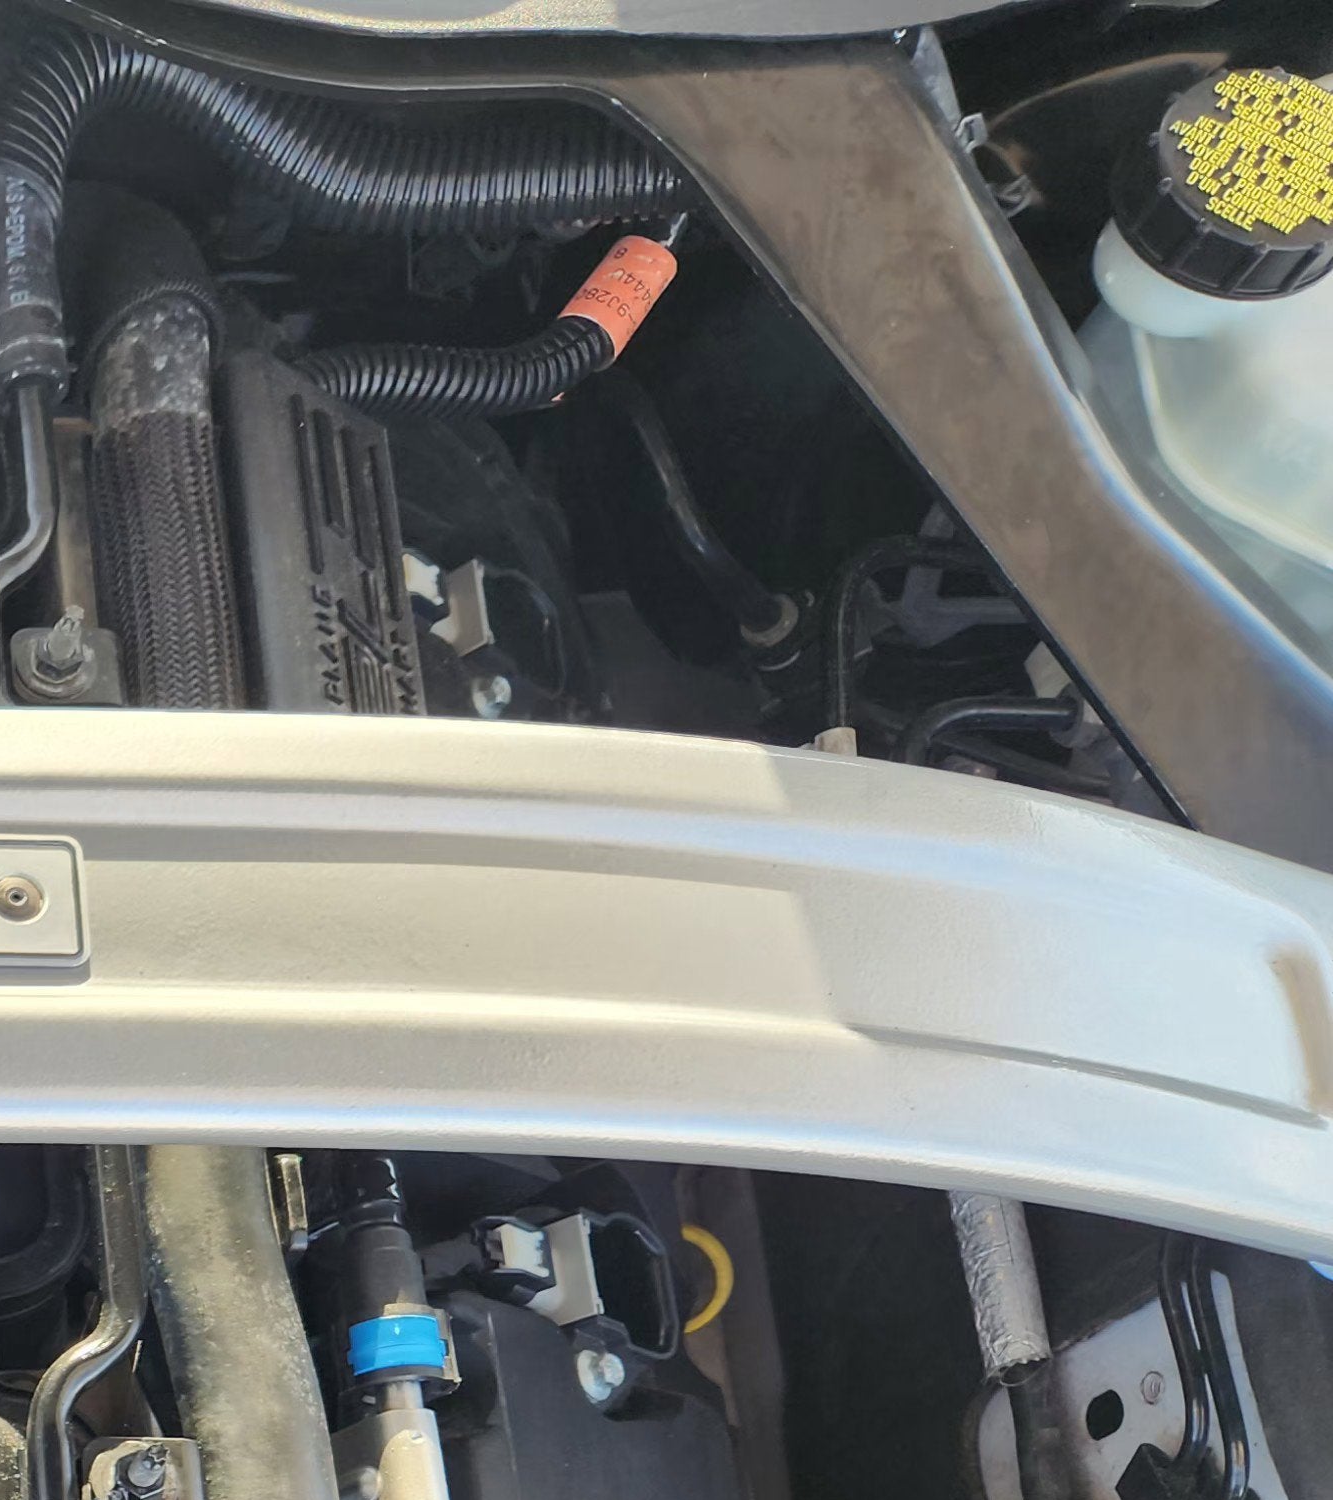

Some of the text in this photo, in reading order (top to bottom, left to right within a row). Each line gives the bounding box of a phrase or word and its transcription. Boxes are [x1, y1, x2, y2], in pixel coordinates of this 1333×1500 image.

[1214, 81, 1251, 104] ONLY
[1252, 98, 1281, 117] DOT
[1282, 114, 1293, 127] 4
[1226, 73, 1277, 101] BEFORE
[1249, 71, 1293, 97] CLEAN
[1215, 97, 1229, 110] A
[1232, 103, 1282, 134] SEALED
[1169, 120, 1213, 146] AVANT
[1216, 139, 1238, 159] DE
[1238, 150, 1260, 167] LE
[1194, 116, 1261, 153] NETTOYER
[1263, 148, 1284, 164] LE
[1177, 137, 1333, 225] PLOYER QUE DU LIQUIDE
[1189, 157, 1311, 224] DOT 4 PROVENANT
[1205, 196, 1255, 232] SCELLE
[1223, 188, 1298, 234] CONTENANT
